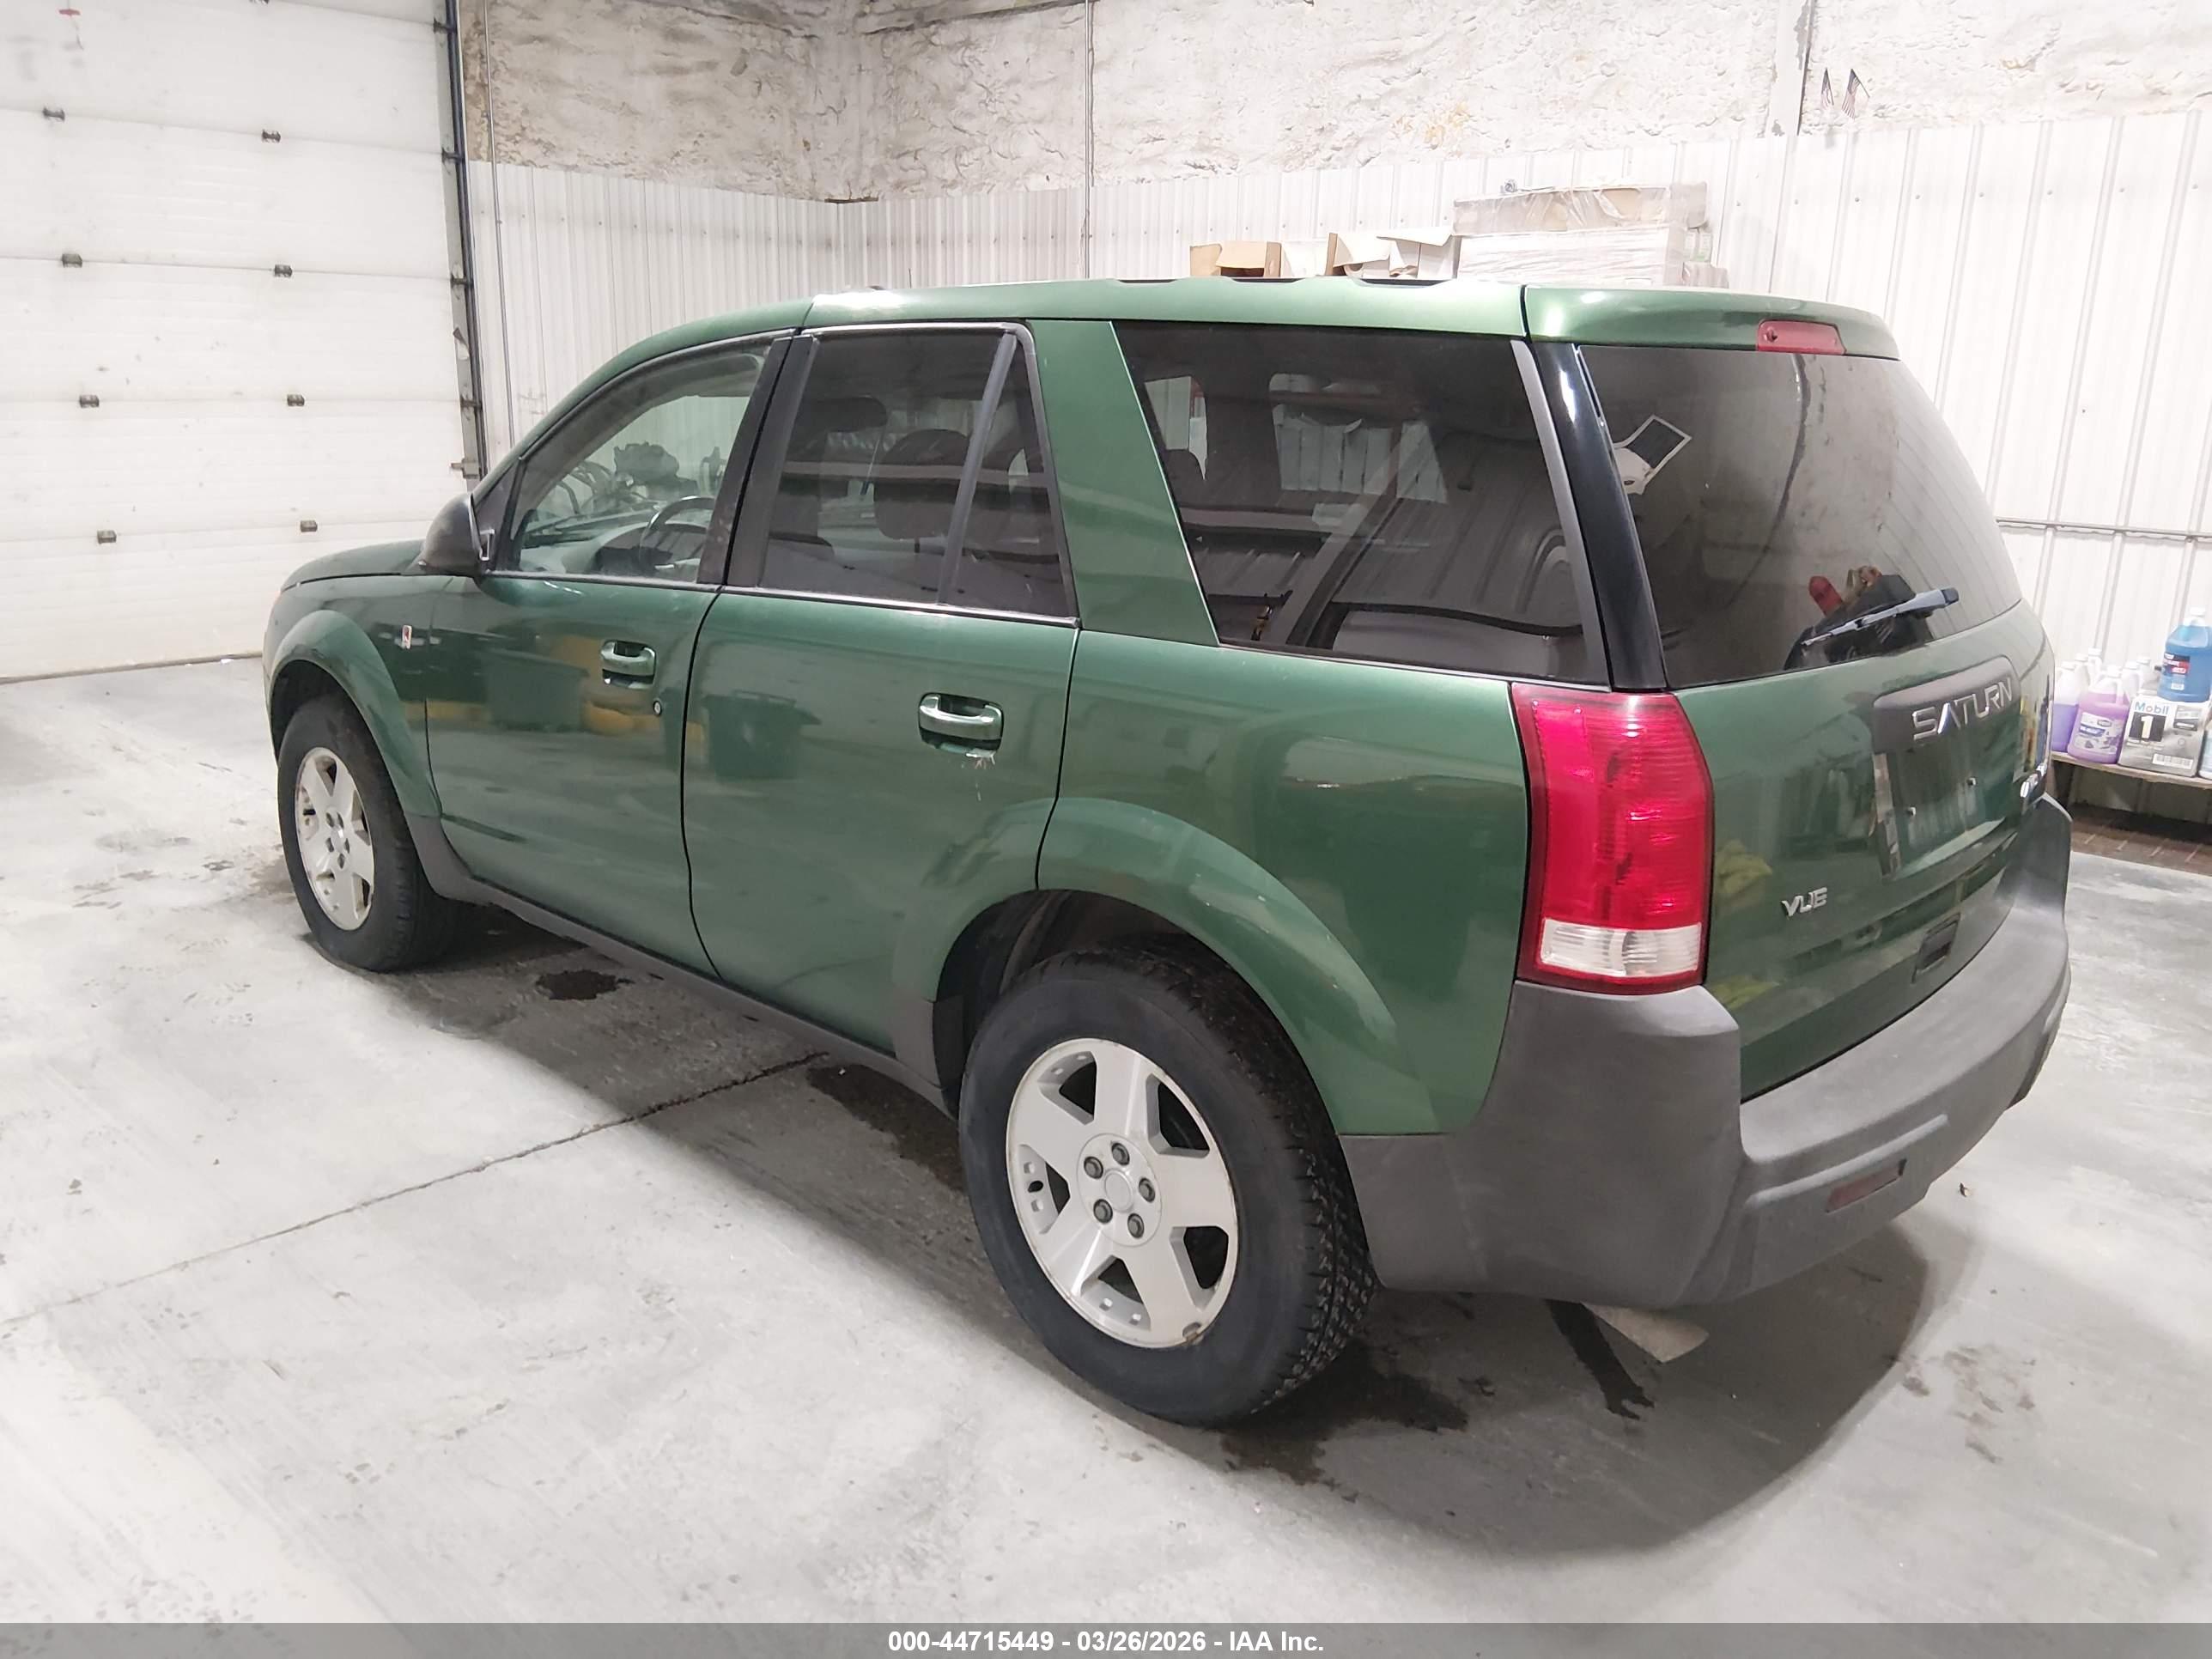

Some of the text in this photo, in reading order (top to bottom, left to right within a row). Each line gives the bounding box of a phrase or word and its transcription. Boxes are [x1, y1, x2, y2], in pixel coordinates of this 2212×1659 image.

[1911, 677, 2012, 741] SATURN
[2135, 702, 2169, 714] Mobil
[2141, 715, 2154, 739] 1
[1781, 887, 1827, 917] VUE
